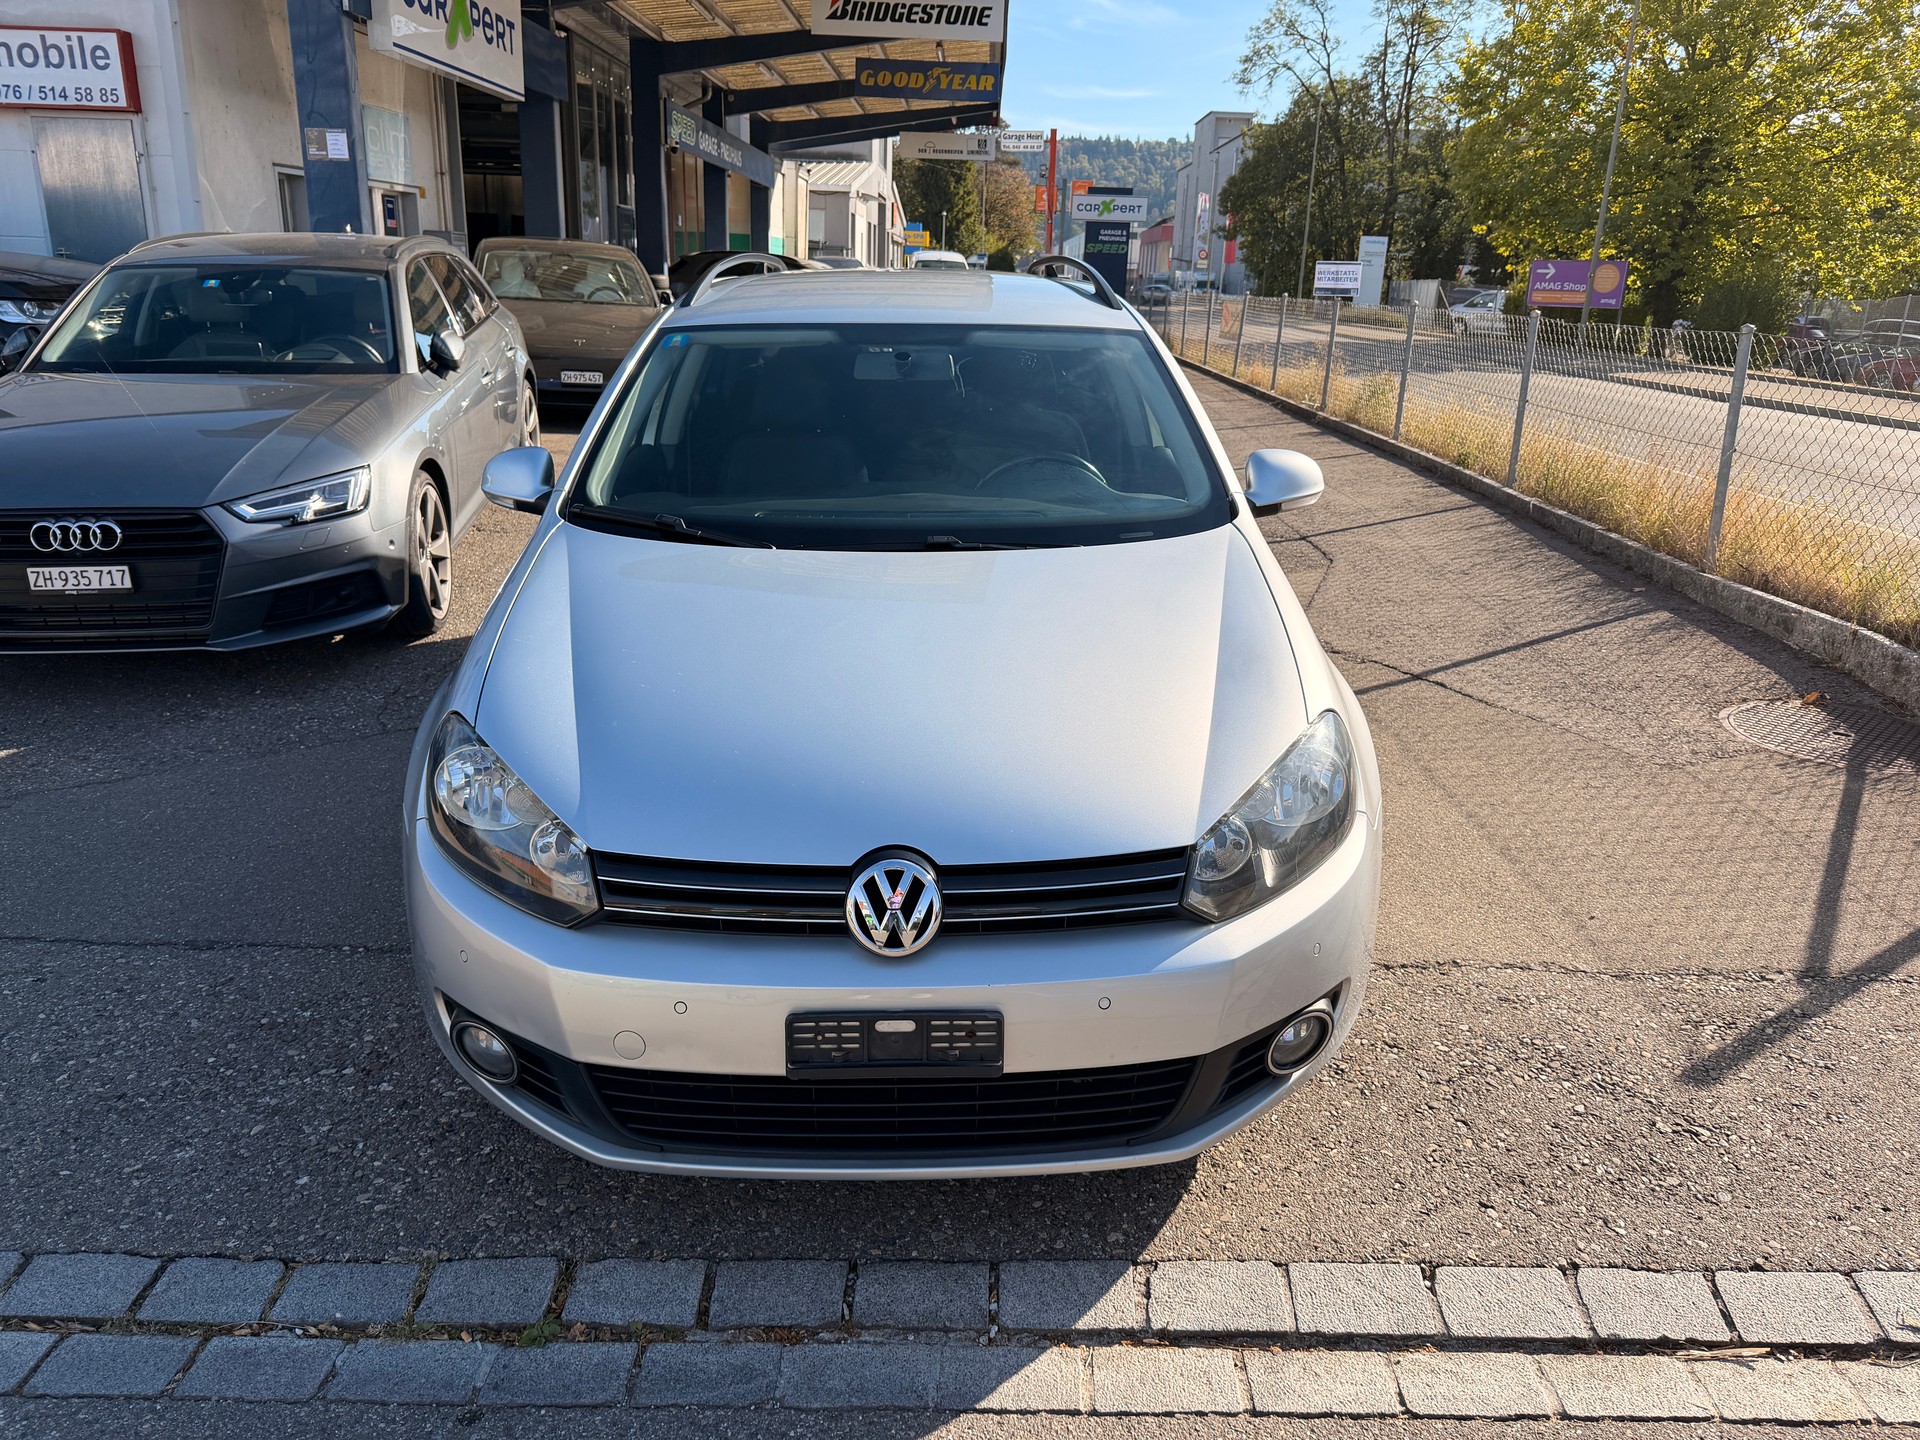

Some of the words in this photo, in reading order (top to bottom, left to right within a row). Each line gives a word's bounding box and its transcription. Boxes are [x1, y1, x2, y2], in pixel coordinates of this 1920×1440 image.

[825, 0, 993, 26] BRIDGESTONE
[0, 84, 22, 100] 76
[27, 84, 32, 100] /
[38, 86, 69, 101] 514
[74, 87, 94, 102] 58
[99, 88, 119, 103] 85
[367, 118, 411, 159] clim
[671, 110, 697, 146] SPEED
[699, 130, 719, 157] GARAGE
[1003, 132, 1025, 142] Garage
[1026, 132, 1043, 141] Heiri
[1085, 243, 1128, 254] SPEED
[1534, 281, 1561, 290] AMAG
[1563, 282, 1587, 292] Shop
